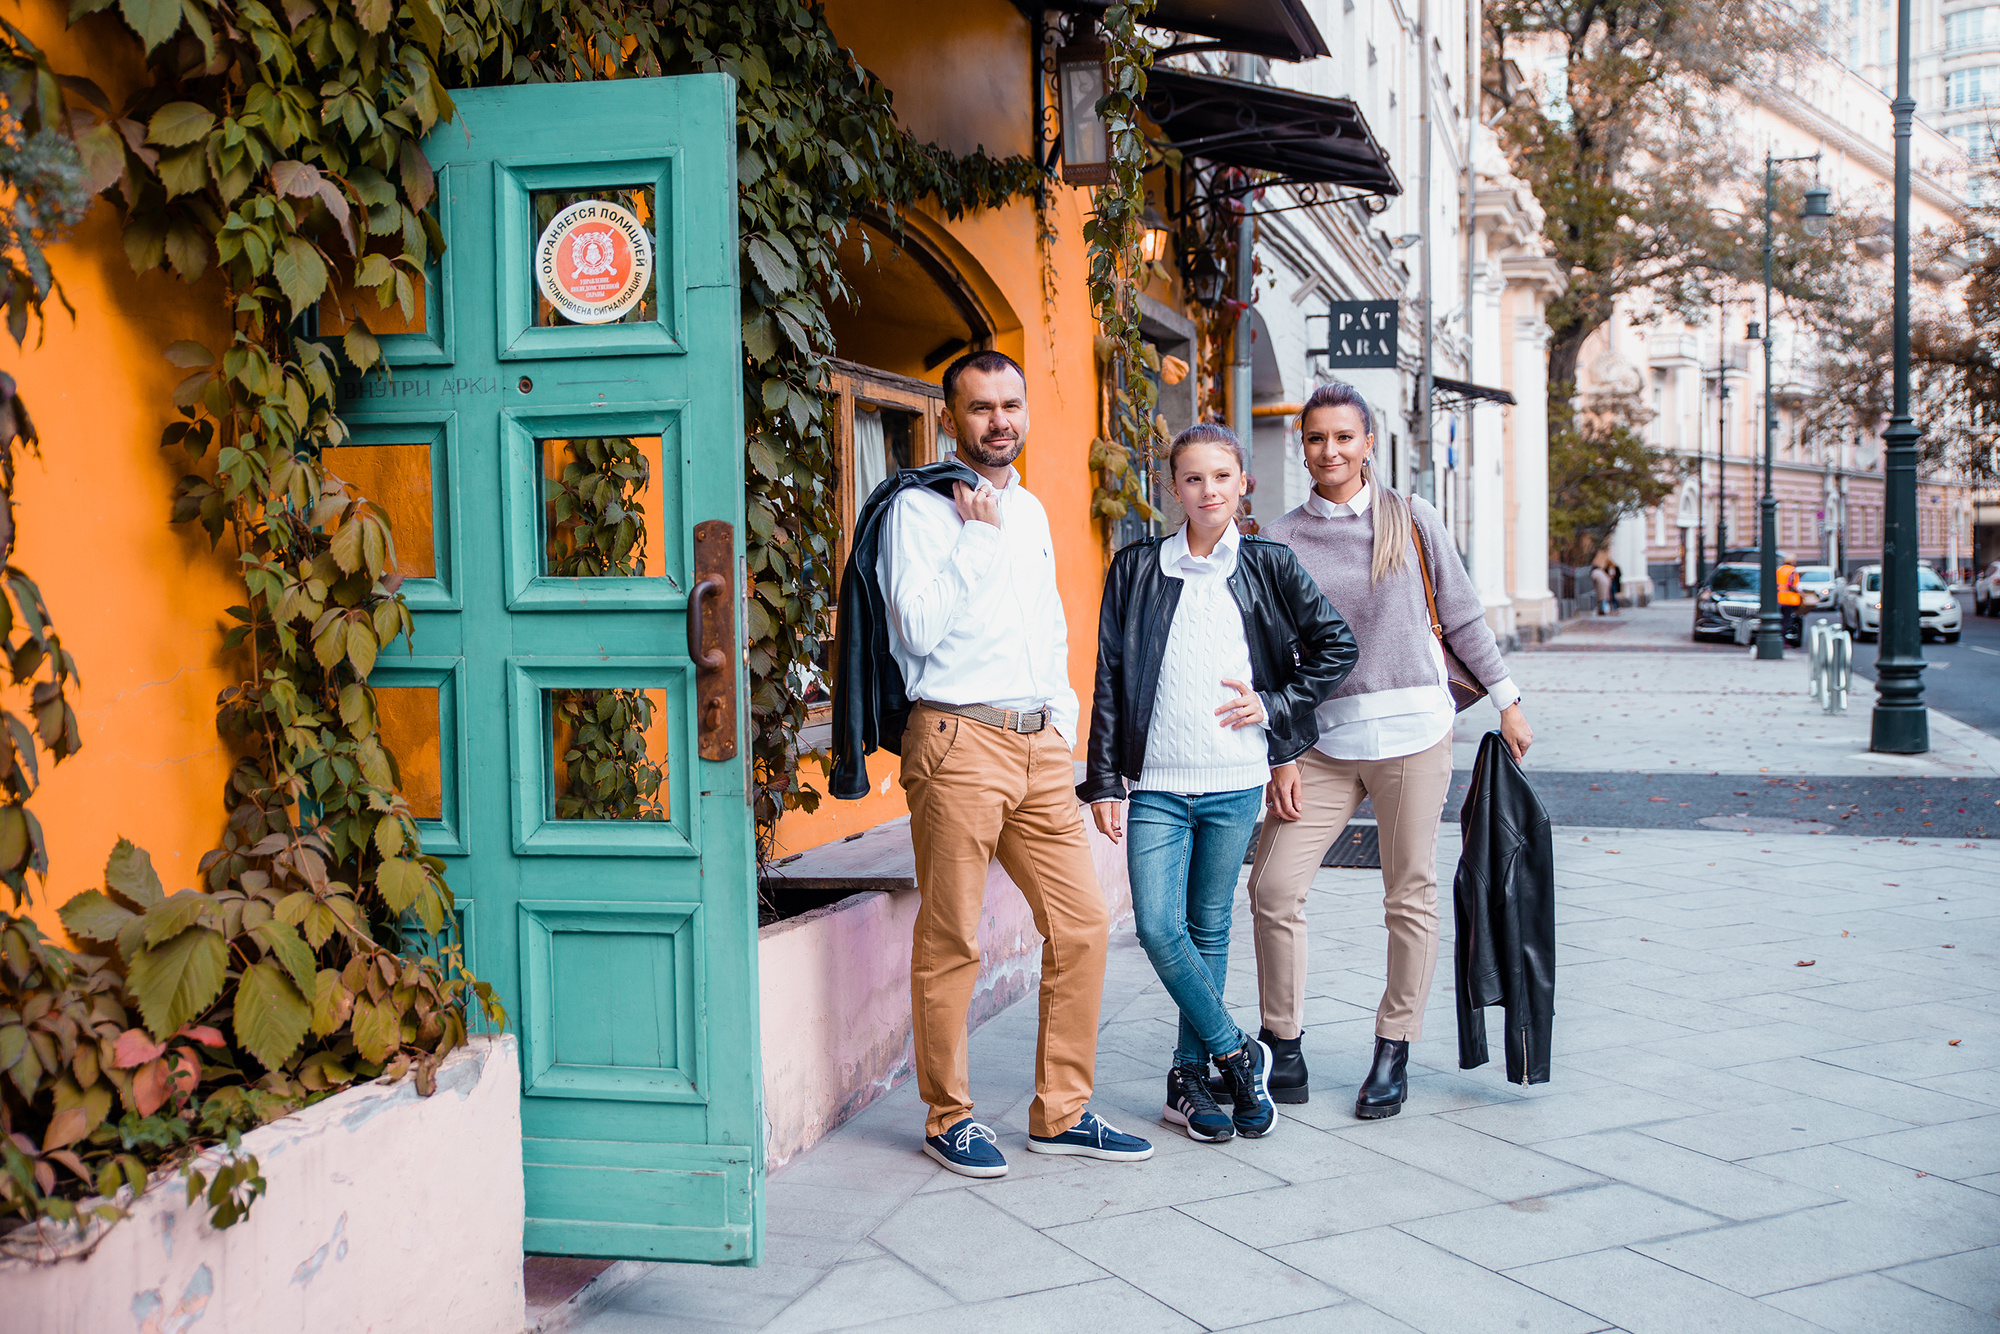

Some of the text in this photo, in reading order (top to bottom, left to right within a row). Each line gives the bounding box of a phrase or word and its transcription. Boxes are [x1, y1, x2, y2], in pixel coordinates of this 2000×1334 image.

[542, 207, 648, 274] ОХРАНЯЕТСЯ ПОЛИЦИЕЙ
[547, 271, 643, 316] УСТАНОВЛЕНА СИГНАЛИЗАЦИЯ
[1336, 338, 1390, 357] ARA
[344, 376, 498, 399] ВНУТРИ АРКИ
